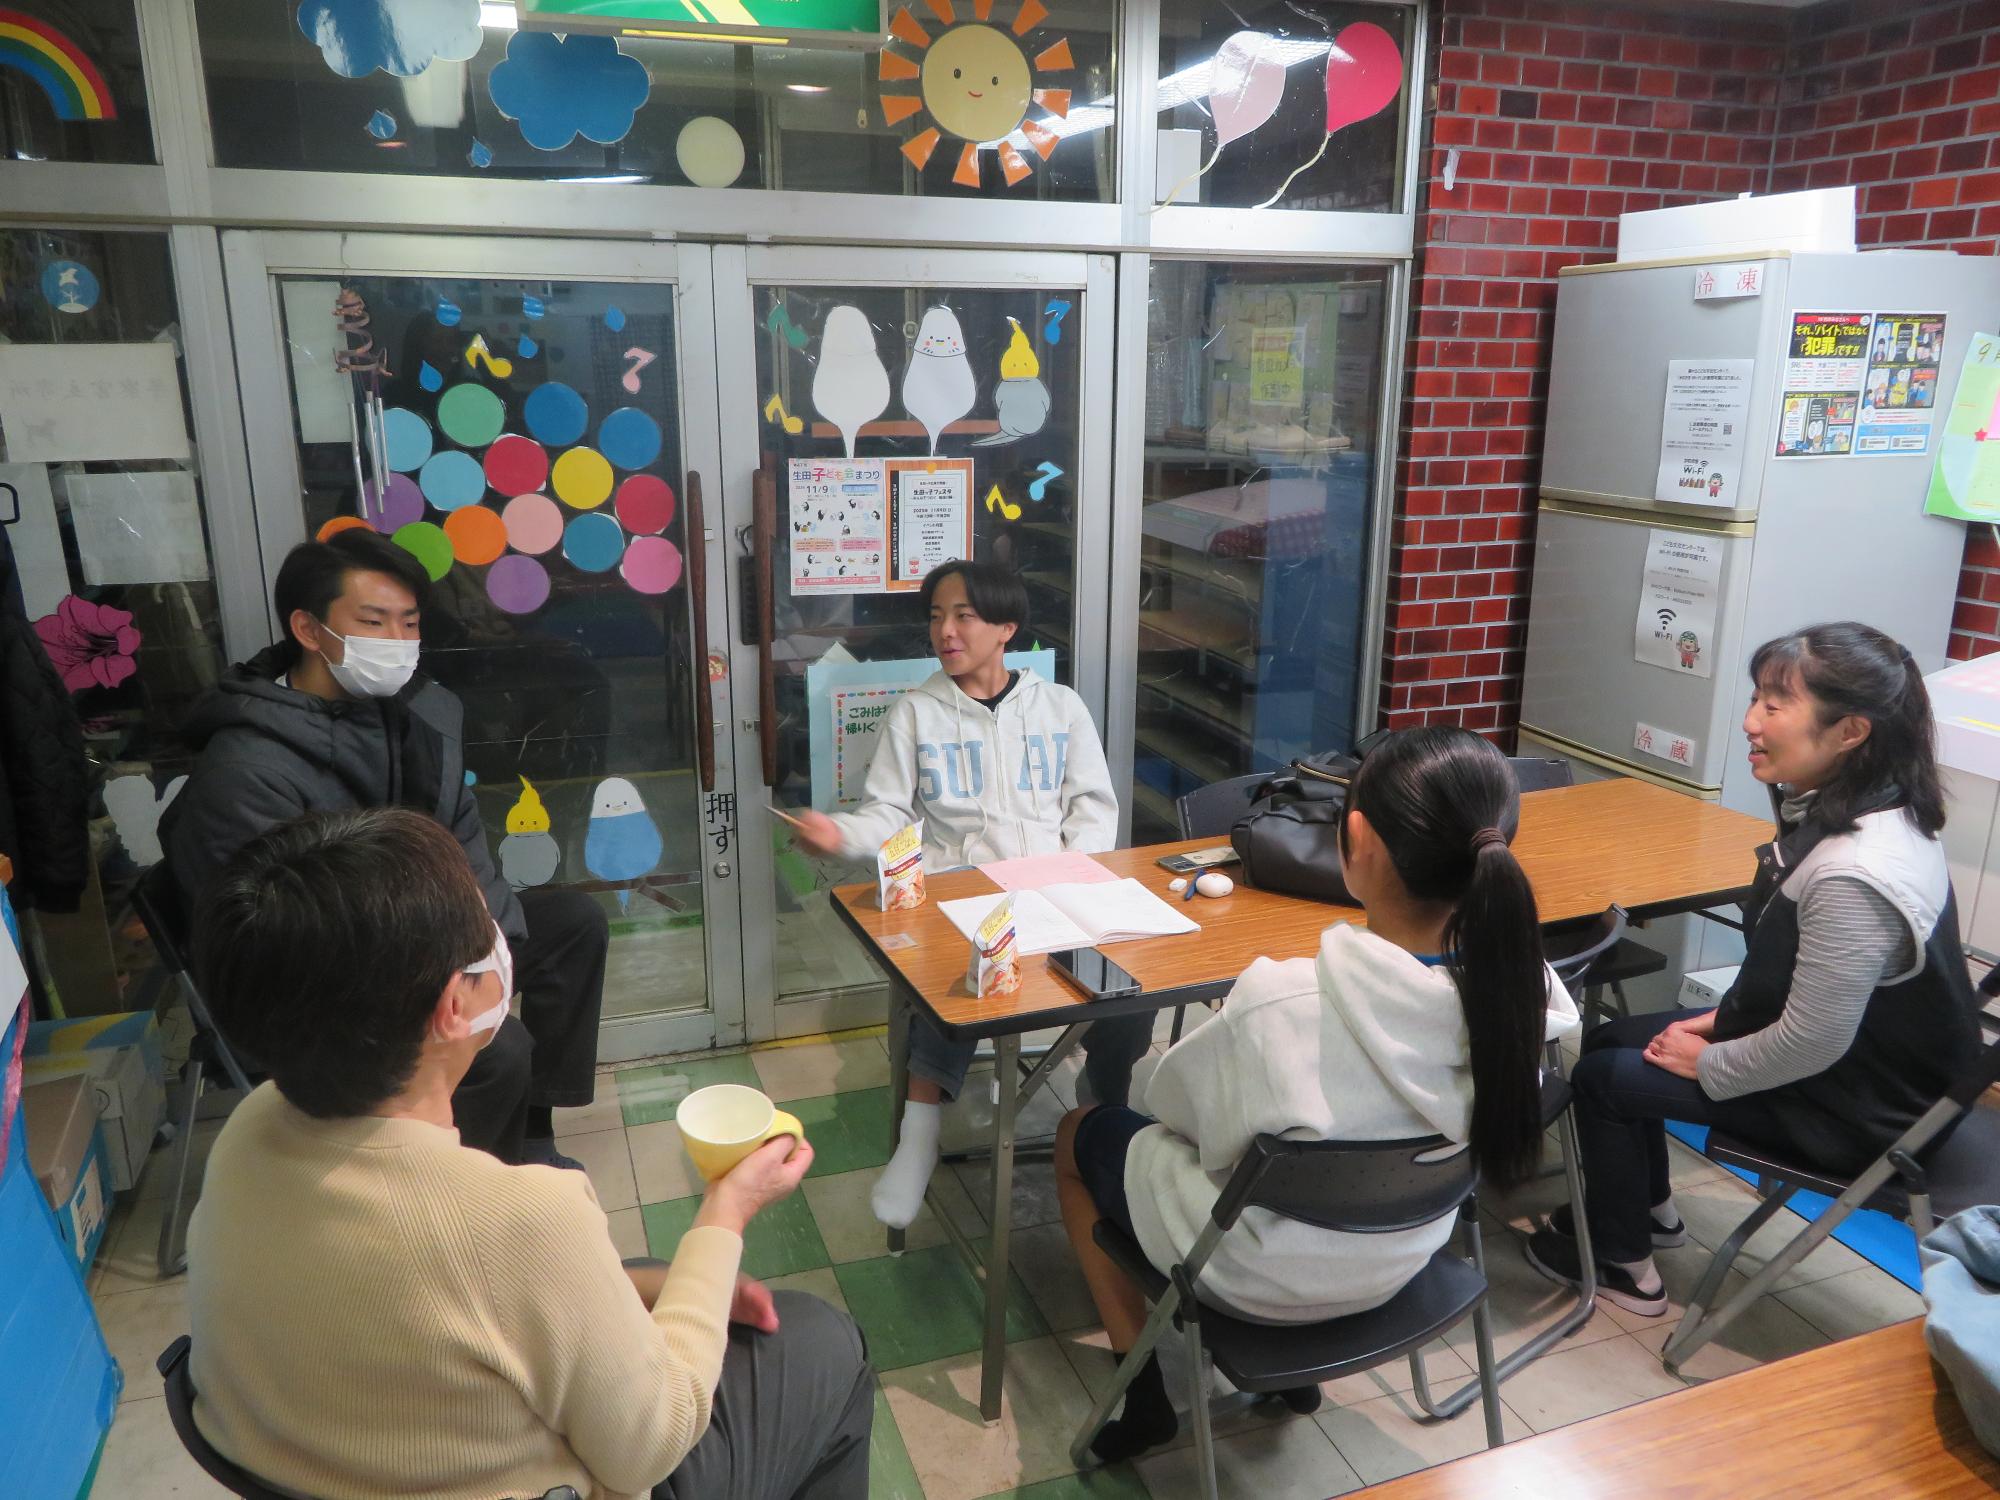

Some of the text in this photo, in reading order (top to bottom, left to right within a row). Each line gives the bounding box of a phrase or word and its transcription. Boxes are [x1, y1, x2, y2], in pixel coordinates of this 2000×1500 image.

[1697, 268, 1758, 295] 冷凍
[1795, 324, 1869, 336] それ、「バイト」ではなく
[793, 468, 880, 482] 生田子ども会まつり
[1683, 466, 1705, 475] Wi-Fi
[849, 704, 889, 719] ごみは
[1637, 729, 1689, 762] 冷蔵
[707, 793, 734, 854] 押す
